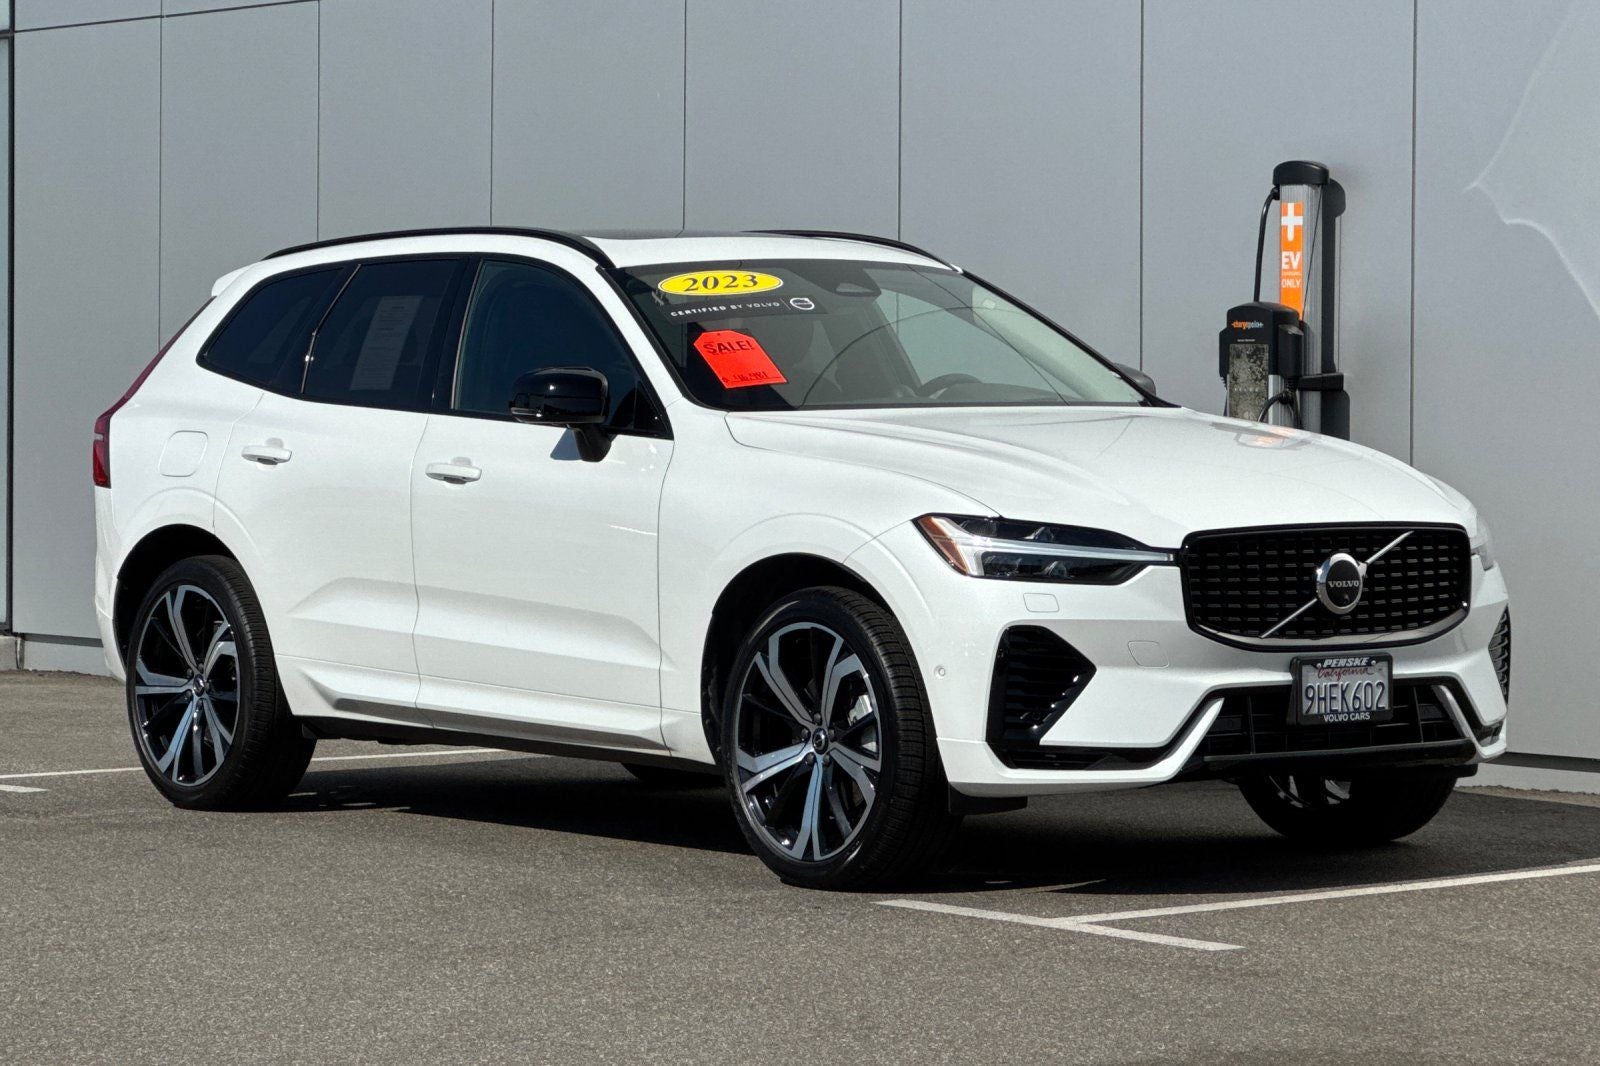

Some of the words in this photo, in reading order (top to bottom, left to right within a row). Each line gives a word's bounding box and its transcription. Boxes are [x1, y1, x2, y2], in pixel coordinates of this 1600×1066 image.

[1281, 251, 1301, 270] EV
[683, 274, 759, 292] 2023
[1281, 279, 1301, 288] ONLY
[670, 306, 727, 317] CERTIFIED
[746, 301, 780, 309] VOLVO
[703, 340, 754, 355] SALE!
[1328, 580, 1359, 588] VOLVO
[1323, 657, 1371, 668] PENSKE
[1317, 667, 1374, 681] California
[1304, 680, 1385, 715] 9HEK602
[1323, 713, 1348, 722] VOLVO
[1349, 712, 1371, 721] CARS
